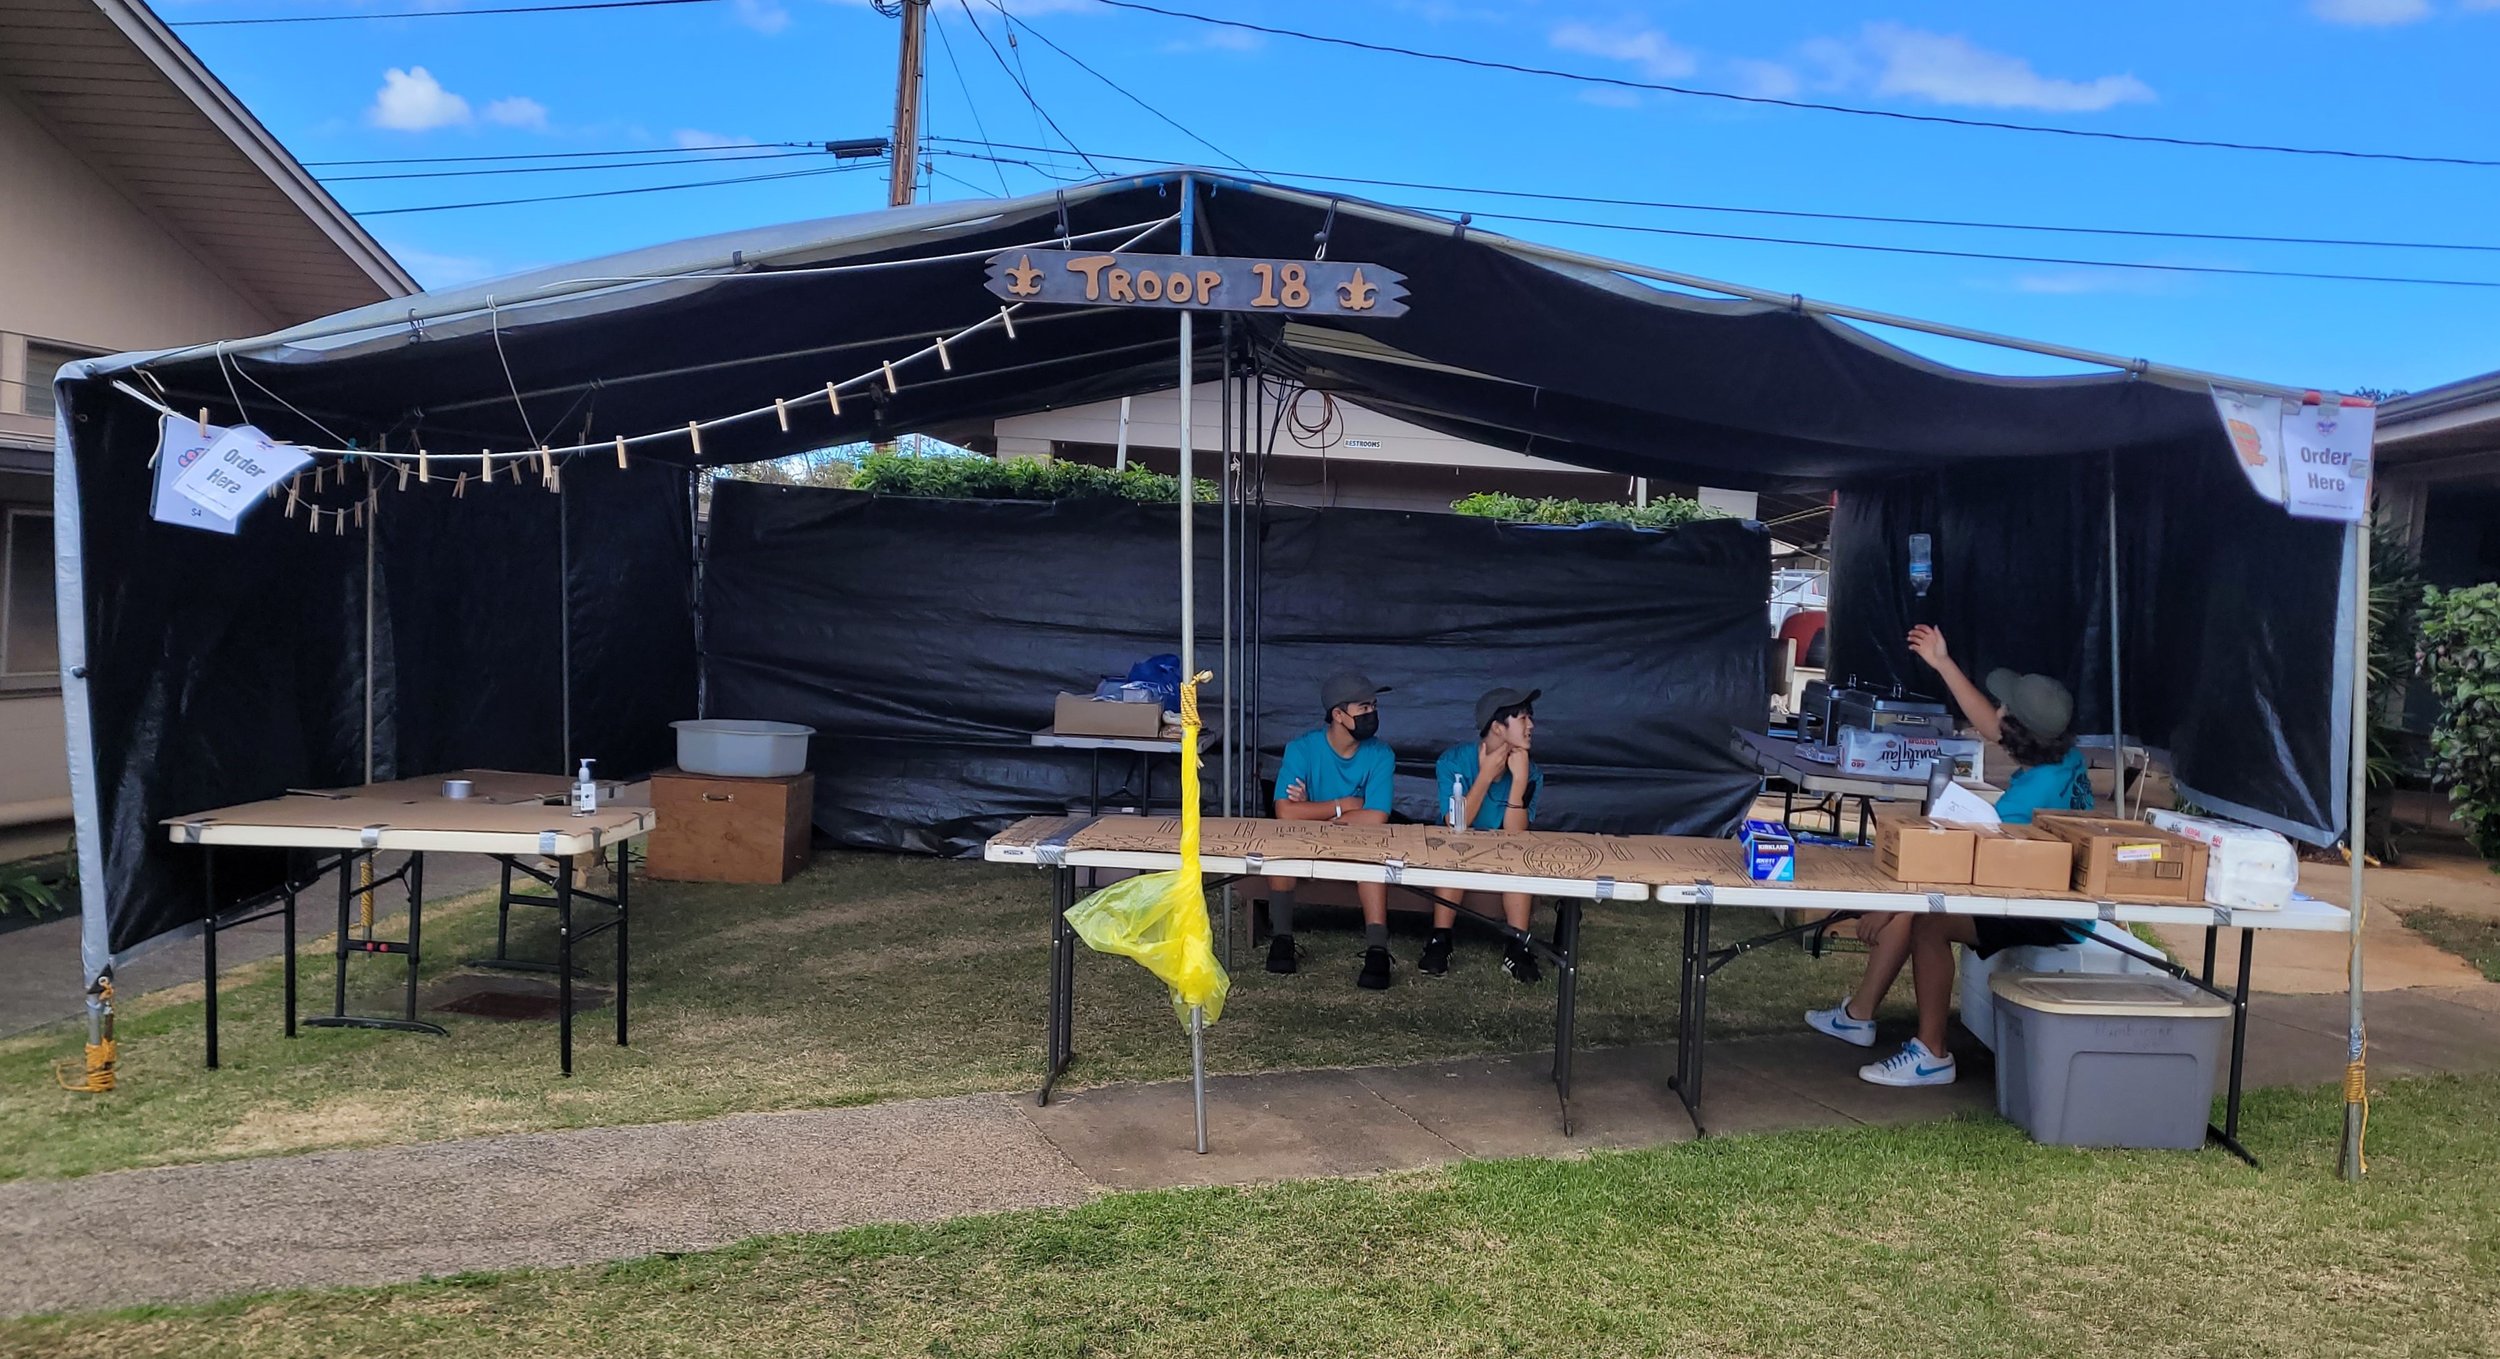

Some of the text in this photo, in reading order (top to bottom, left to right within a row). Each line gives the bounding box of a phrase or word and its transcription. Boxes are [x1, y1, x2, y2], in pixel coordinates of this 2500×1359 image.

[1066, 255, 1311, 308] TROOP 18
[1345, 440, 1380, 448] RESTROOMS
[2300, 446, 2352, 465] Order
[223, 448, 266, 477] Order
[206, 468, 242, 494] Here
[2307, 471, 2346, 492] Here
[1875, 742, 1902, 771] fair
